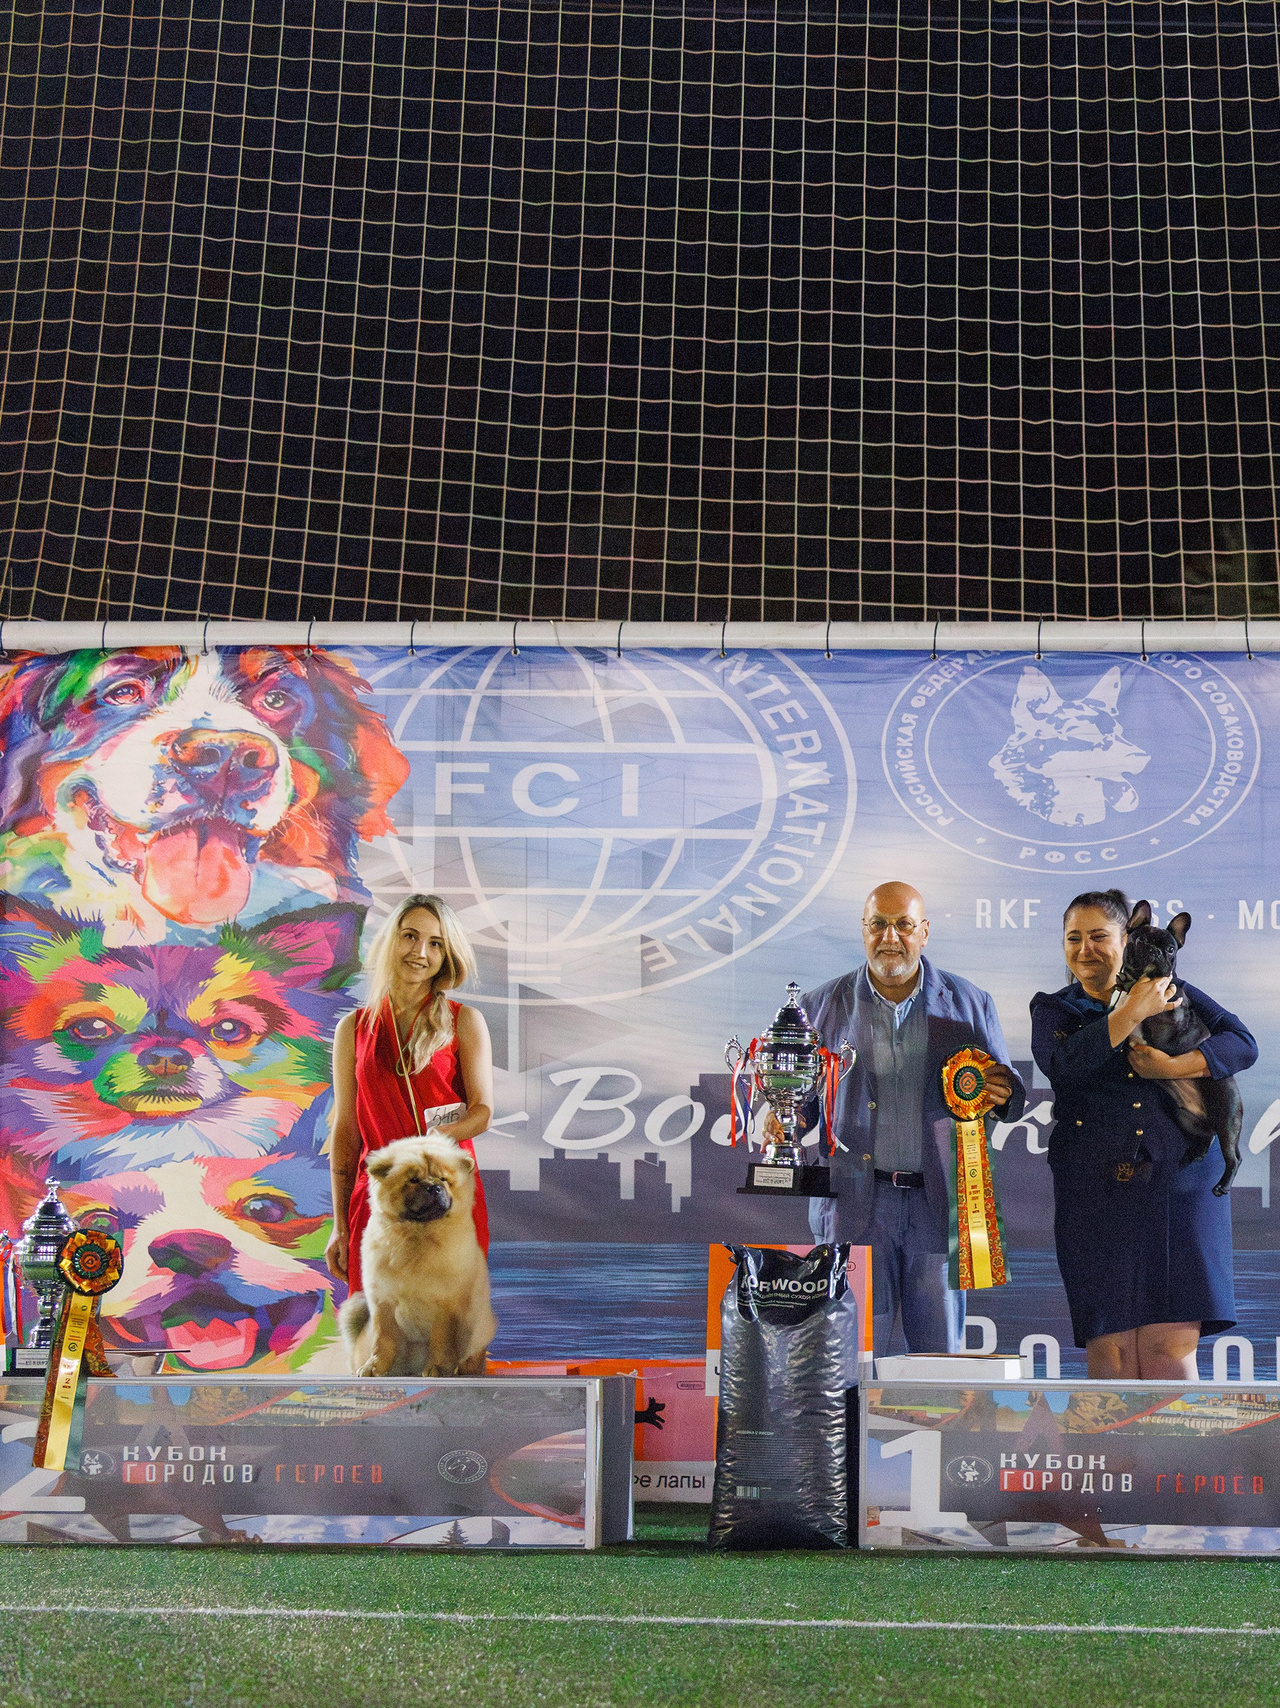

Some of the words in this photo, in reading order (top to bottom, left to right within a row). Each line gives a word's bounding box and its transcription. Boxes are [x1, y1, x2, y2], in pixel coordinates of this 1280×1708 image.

[895, 713, 954, 826] РОССИЙСКАЯ
[1184, 682, 1244, 825] СОБАКОВОДСТВА
[435, 762, 639, 817] FCI
[1019, 846, 1118, 863] РФСС
[976, 899, 1041, 928] RKF
[123, 1446, 227, 1461] КУБОК
[1000, 1453, 1106, 1470] КУБОК
[125, 1463, 254, 1485] ГОРОДОВ
[275, 1464, 383, 1484] ГЕРОЕВ
[656, 1475, 705, 1488] лапы
[880, 1430, 967, 1528] 1
[1003, 1471, 1132, 1494] ГОРОДОВ
[1155, 1473, 1264, 1495] ГЕРОЕВ
